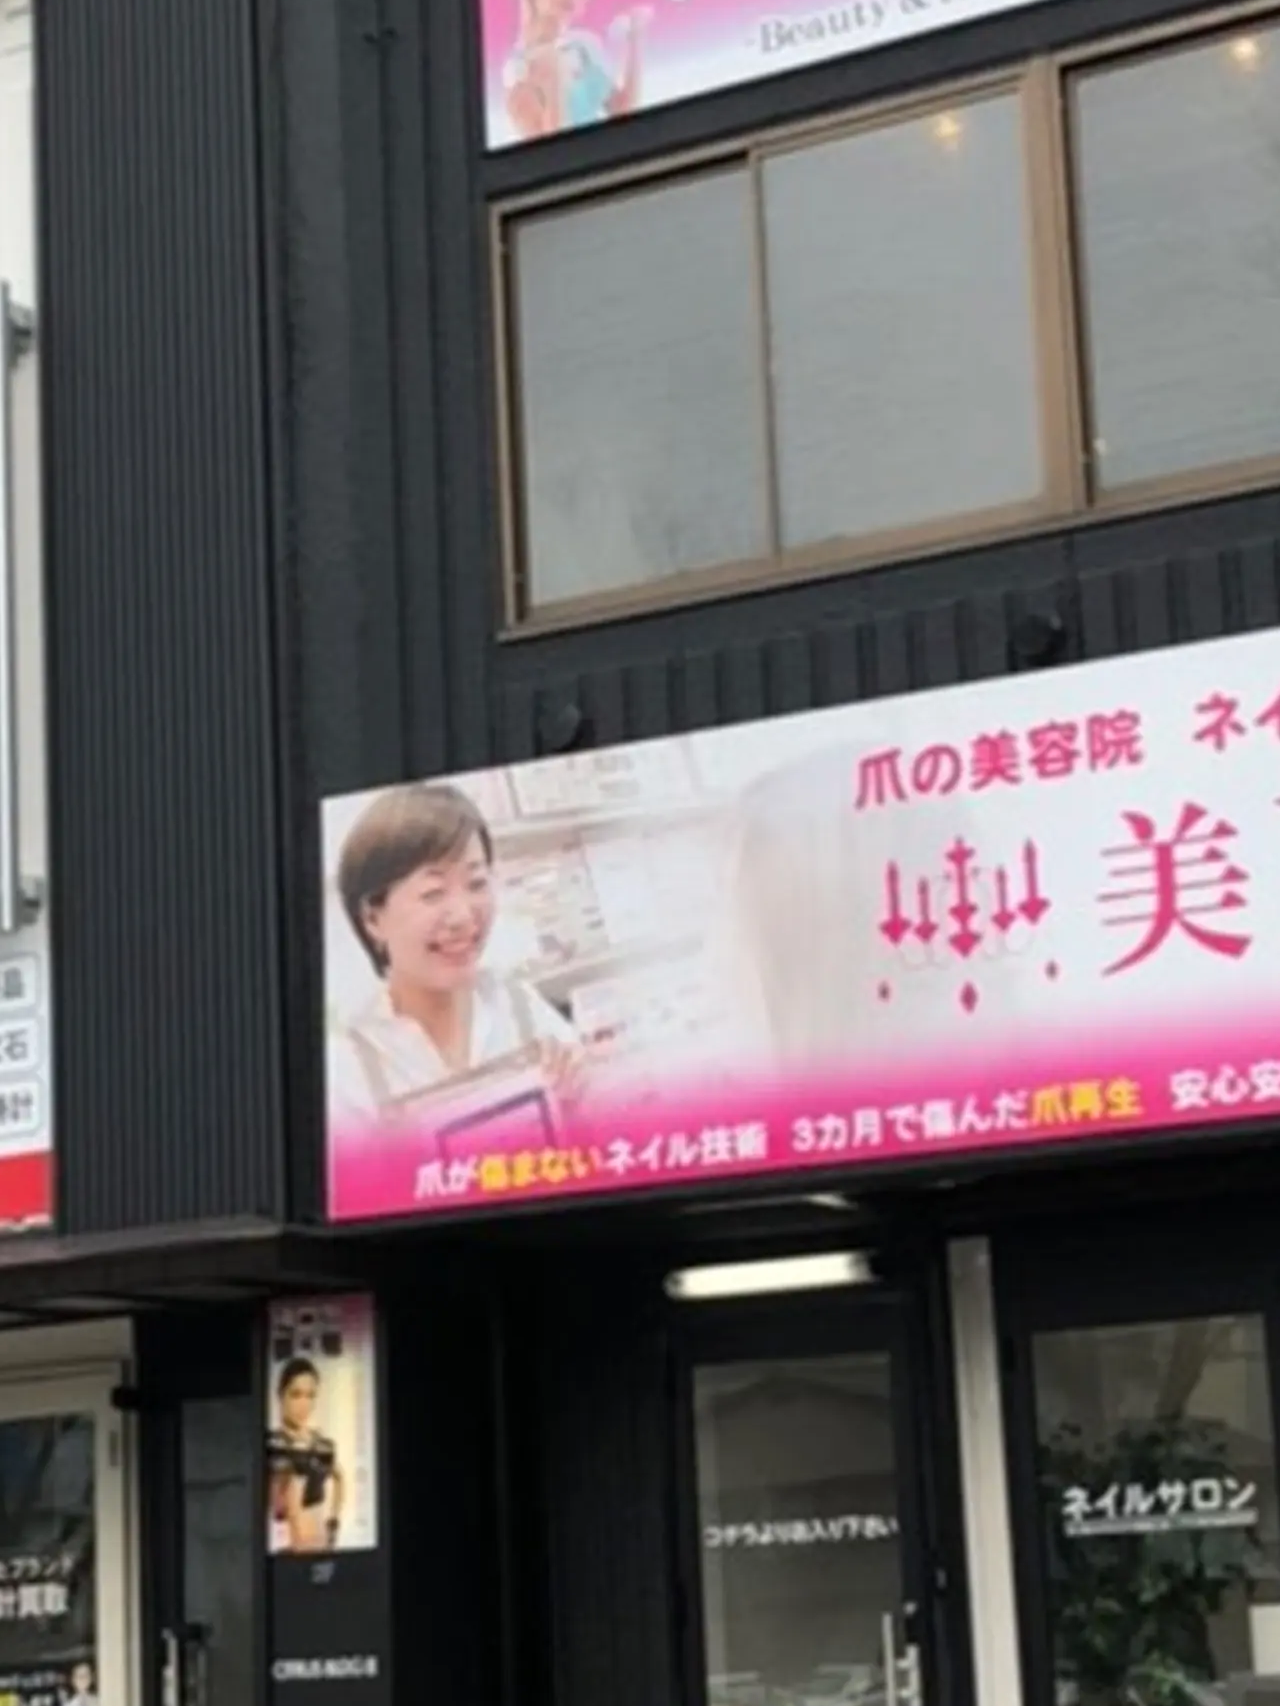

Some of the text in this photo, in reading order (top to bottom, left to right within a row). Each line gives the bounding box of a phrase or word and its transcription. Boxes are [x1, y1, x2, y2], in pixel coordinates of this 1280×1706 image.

[853, 709, 1143, 810] 爪の美容院
[414, 1121, 768, 1201] 爪が傷まないネイル技術
[1062, 1477, 1257, 1522] ネイルサロン
